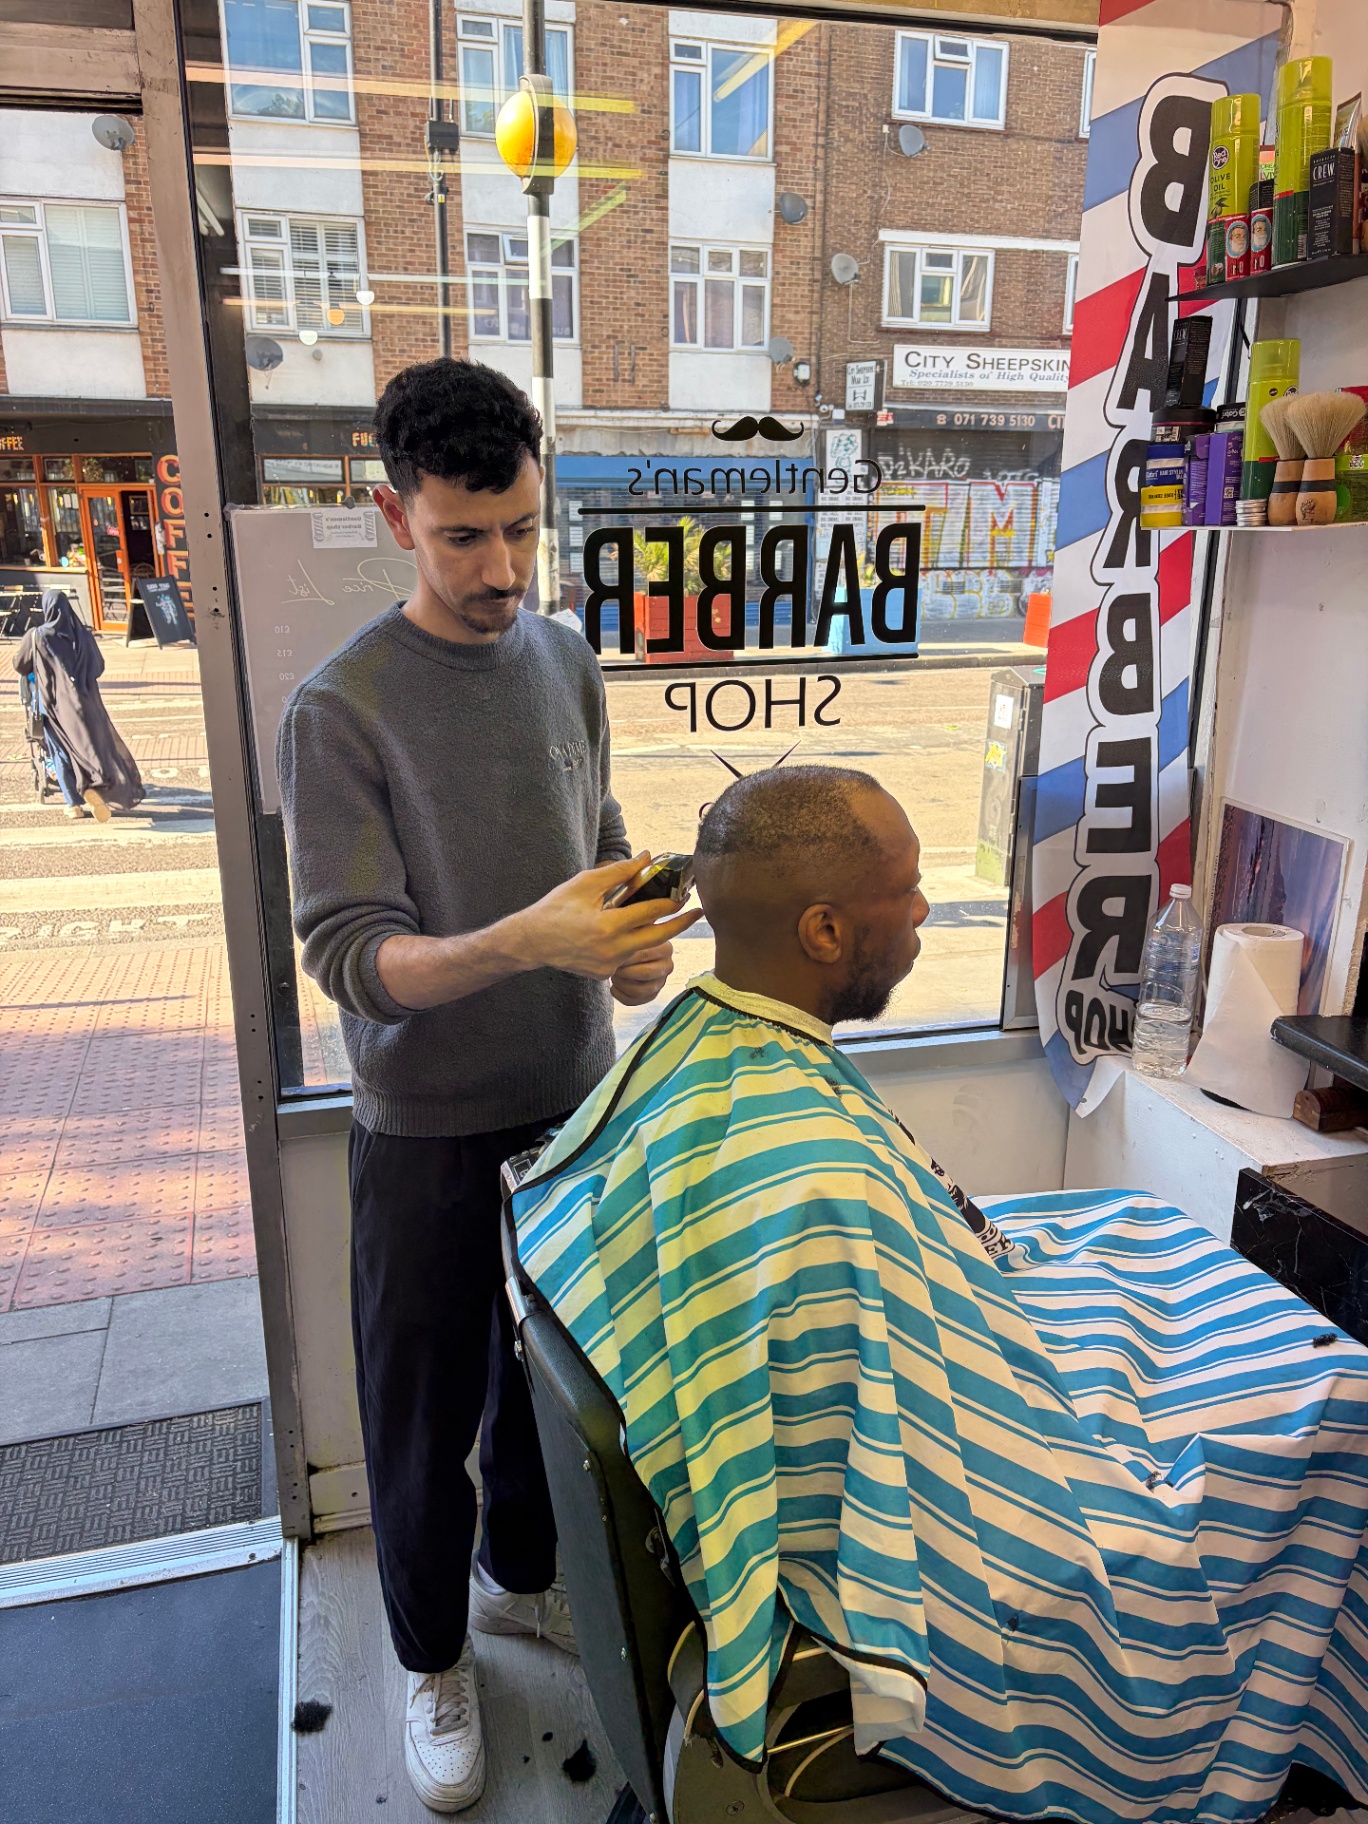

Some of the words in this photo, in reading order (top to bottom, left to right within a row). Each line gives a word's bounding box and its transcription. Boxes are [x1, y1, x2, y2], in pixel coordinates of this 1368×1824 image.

[1209, 172, 1231, 184] OLIVE
[1312, 162, 1336, 181] CREW
[1213, 183, 1226, 192] OIL
[904, 350, 955, 369] CITY
[965, 352, 1070, 372] SHEEPSKIN
[909, 369, 975, 380] Specialists
[996, 371, 1025, 382] High
[953, 413, 976, 426] 071
[980, 414, 1005, 427] 739
[1009, 415, 1036, 428] 5130
[156, 453, 194, 622] COFFE
